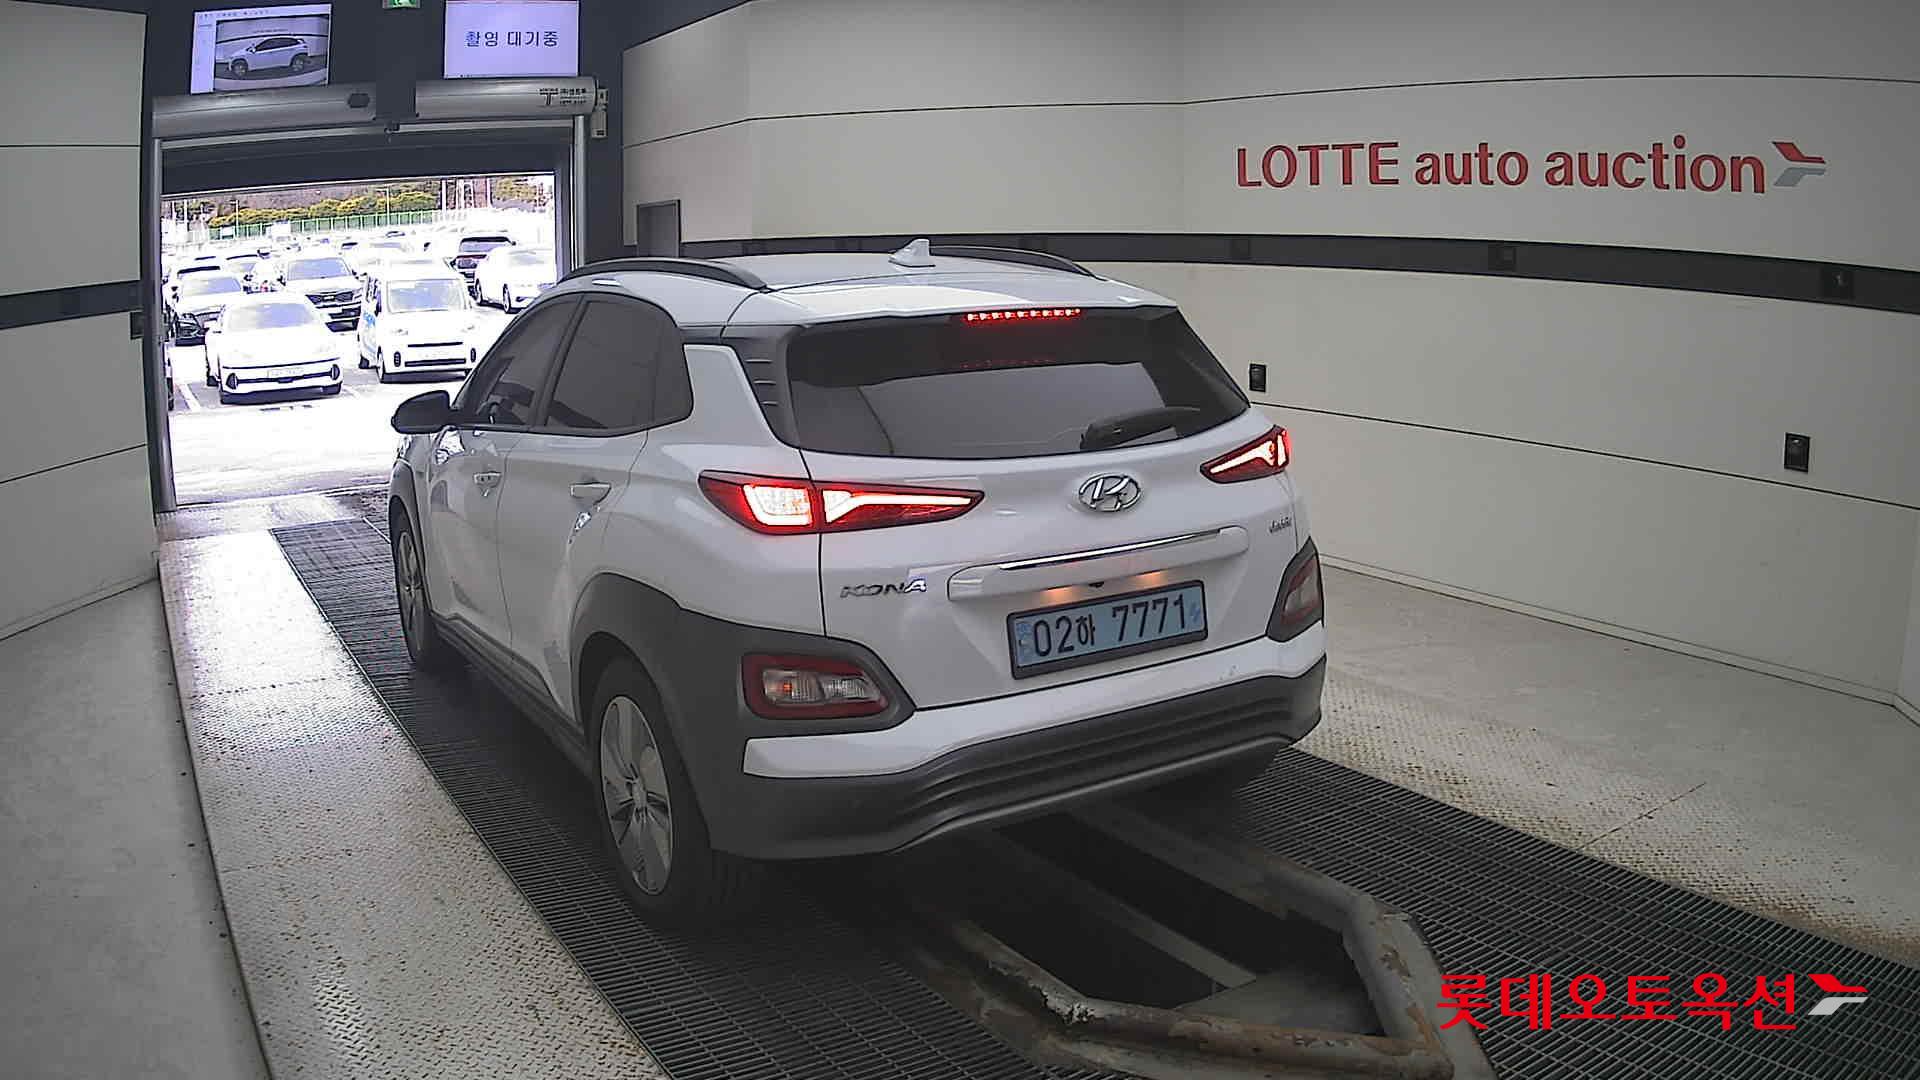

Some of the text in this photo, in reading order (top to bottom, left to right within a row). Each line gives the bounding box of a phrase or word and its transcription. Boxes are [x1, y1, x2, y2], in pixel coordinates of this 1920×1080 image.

[507, 31, 559, 48] 대기중
[1237, 136, 1766, 193] LOTTE auto auction
[840, 578, 927, 598] KONA
[1033, 614, 1096, 657] 02하
[1112, 593, 1185, 642] 7771
